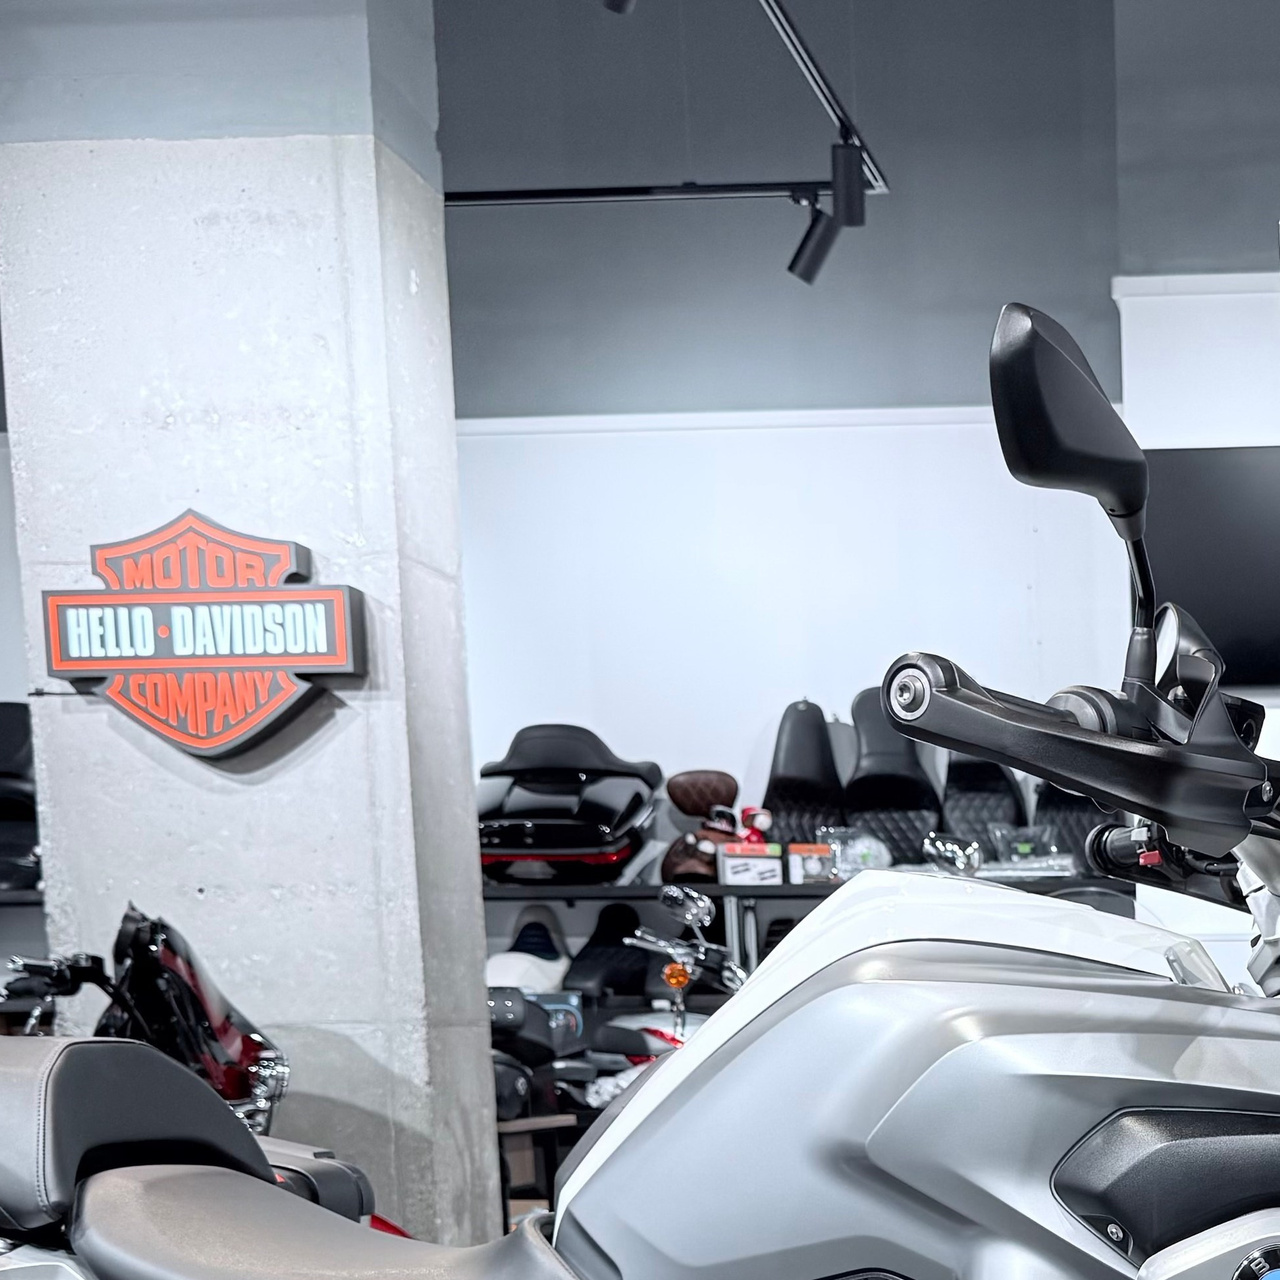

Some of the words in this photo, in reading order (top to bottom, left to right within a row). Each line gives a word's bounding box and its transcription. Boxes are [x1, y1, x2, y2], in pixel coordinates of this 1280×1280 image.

[122, 531, 266, 589] MOTOR
[66, 606, 155, 658] HELLO
[170, 603, 328, 657] DAVIDSON
[129, 671, 274, 736] COMPANY
